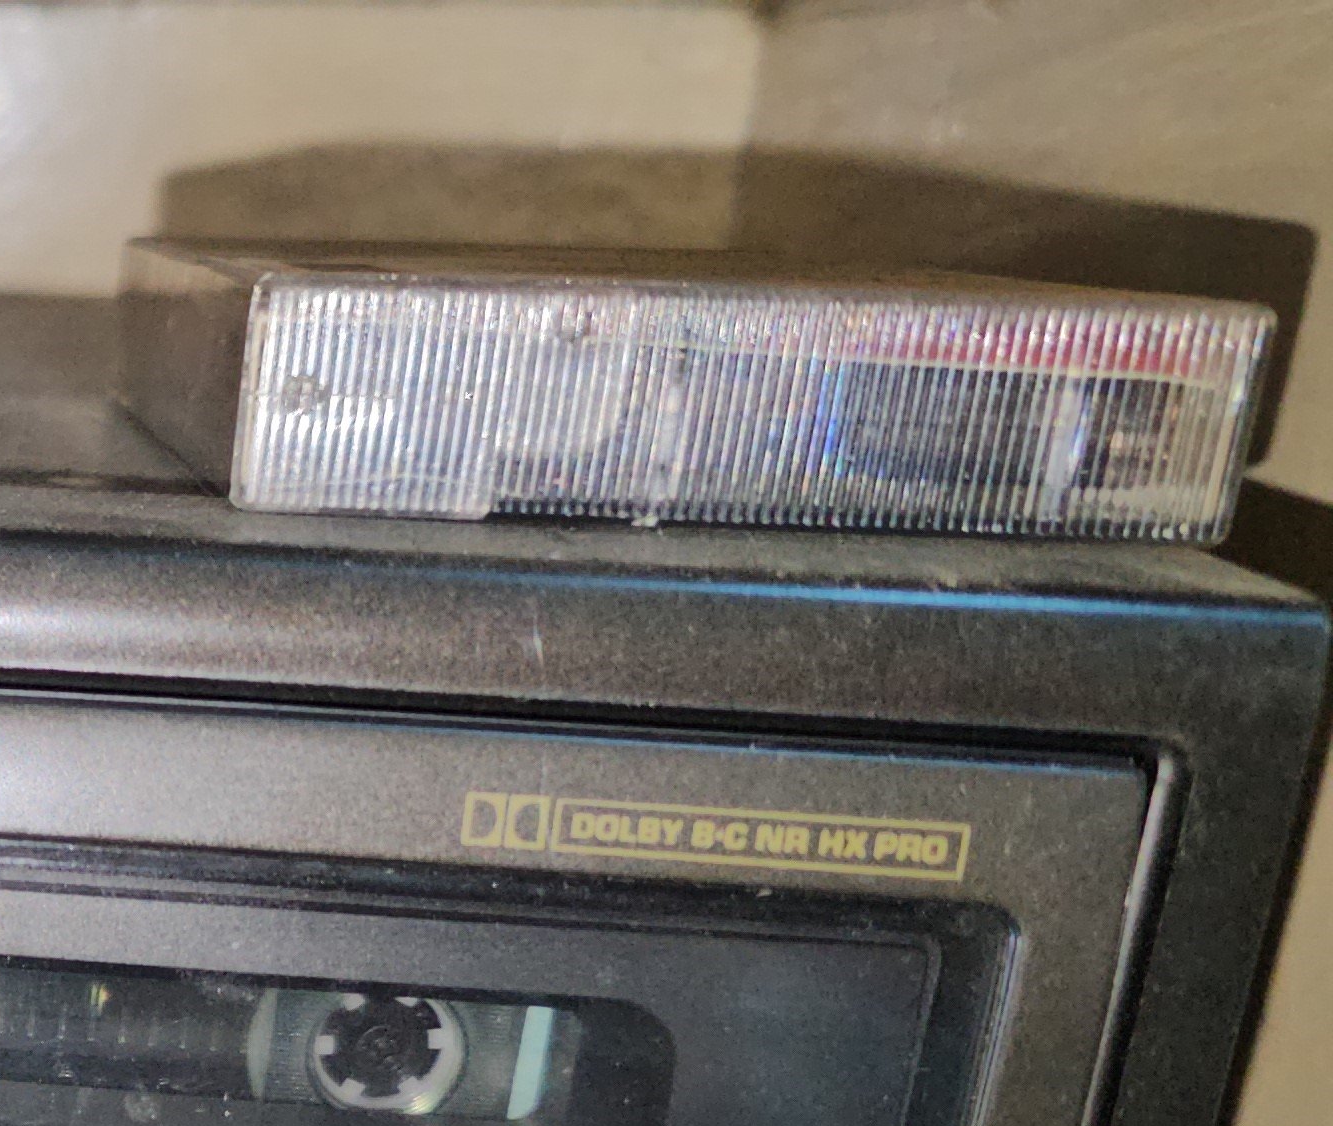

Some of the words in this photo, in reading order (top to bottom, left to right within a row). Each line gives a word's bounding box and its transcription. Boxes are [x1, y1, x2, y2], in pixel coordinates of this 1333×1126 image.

[570, 812, 683, 846] DOLBY
[755, 824, 810, 854] NR
[818, 828, 869, 859] HX
[873, 832, 949, 865] PRO
